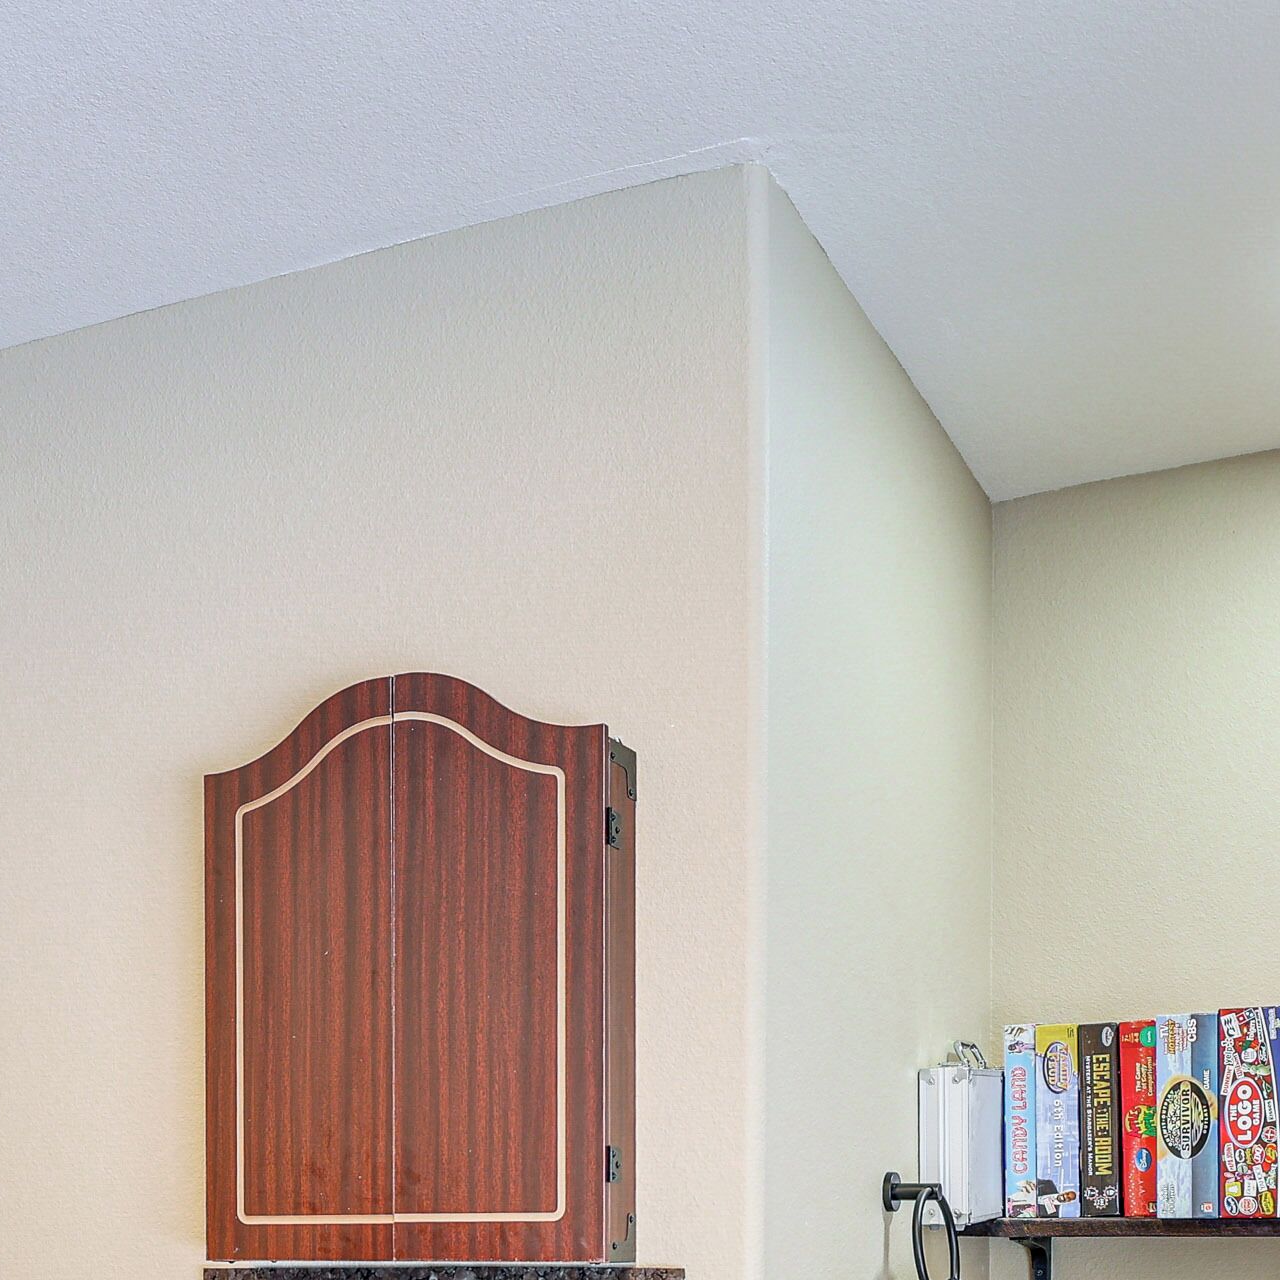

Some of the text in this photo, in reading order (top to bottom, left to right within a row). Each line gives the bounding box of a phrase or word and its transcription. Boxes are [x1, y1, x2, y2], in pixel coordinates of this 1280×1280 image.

[1188, 1019, 1197, 1042] CBS
[1224, 1047, 1234, 1065] yelp
[1086, 1086, 1091, 1094] AT
[1093, 1054, 1111, 1107] ESCAPE
[1012, 1066, 1027, 1174] CANDY LAND
[1096, 1112, 1109, 1131] THE
[1230, 1104, 1238, 1122] THE
[1238, 1083, 1252, 1141] LOGO
[1054, 1099, 1063, 1167] 6th Edition
[1095, 1138, 1112, 1175] ROOM
